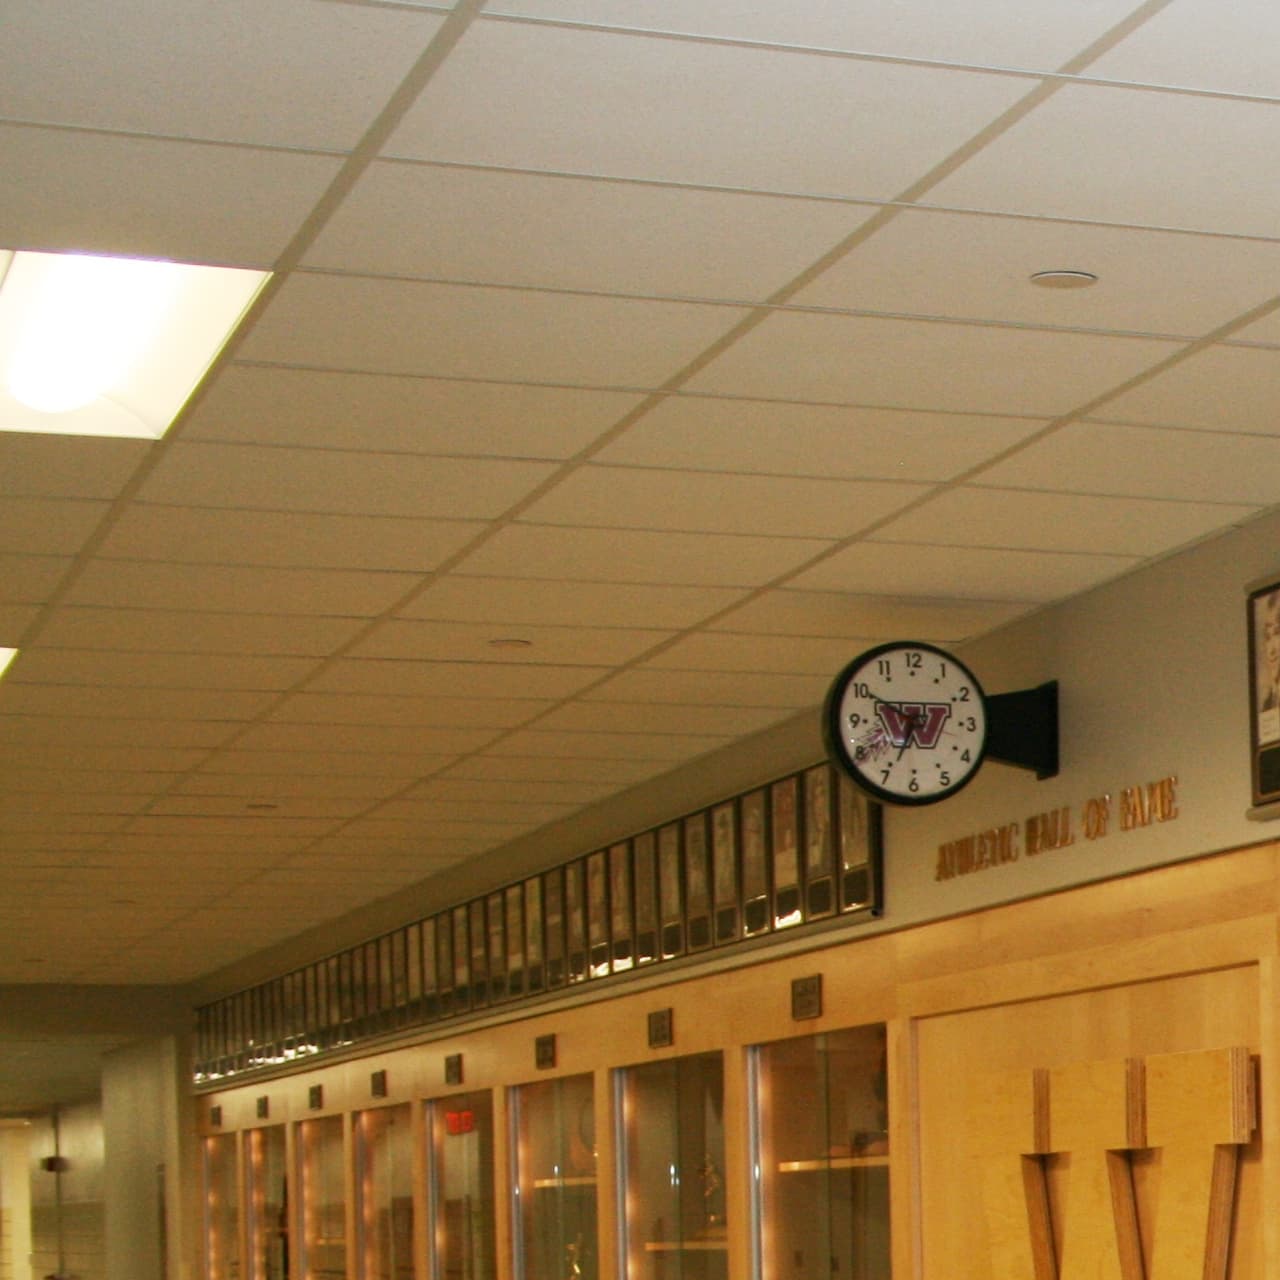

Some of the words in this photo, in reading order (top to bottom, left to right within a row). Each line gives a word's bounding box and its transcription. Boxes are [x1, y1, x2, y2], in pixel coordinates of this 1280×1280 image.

[878, 660, 891, 676] 11
[905, 652, 922, 669] 12
[940, 663, 946, 679] 1
[854, 683, 869, 699] 10
[958, 687, 970, 702] 2
[849, 713, 860, 729] 9
[966, 716, 977, 732] 3
[960, 749, 971, 763] 4
[881, 770, 890, 785] 7
[908, 777, 919, 793] 6
[940, 771, 950, 786] 5
[935, 821, 1021, 882] ATHLETIC
[1025, 806, 1075, 857] HALL
[1082, 793, 1111, 841] OF
[1119, 775, 1179, 832] FAME
